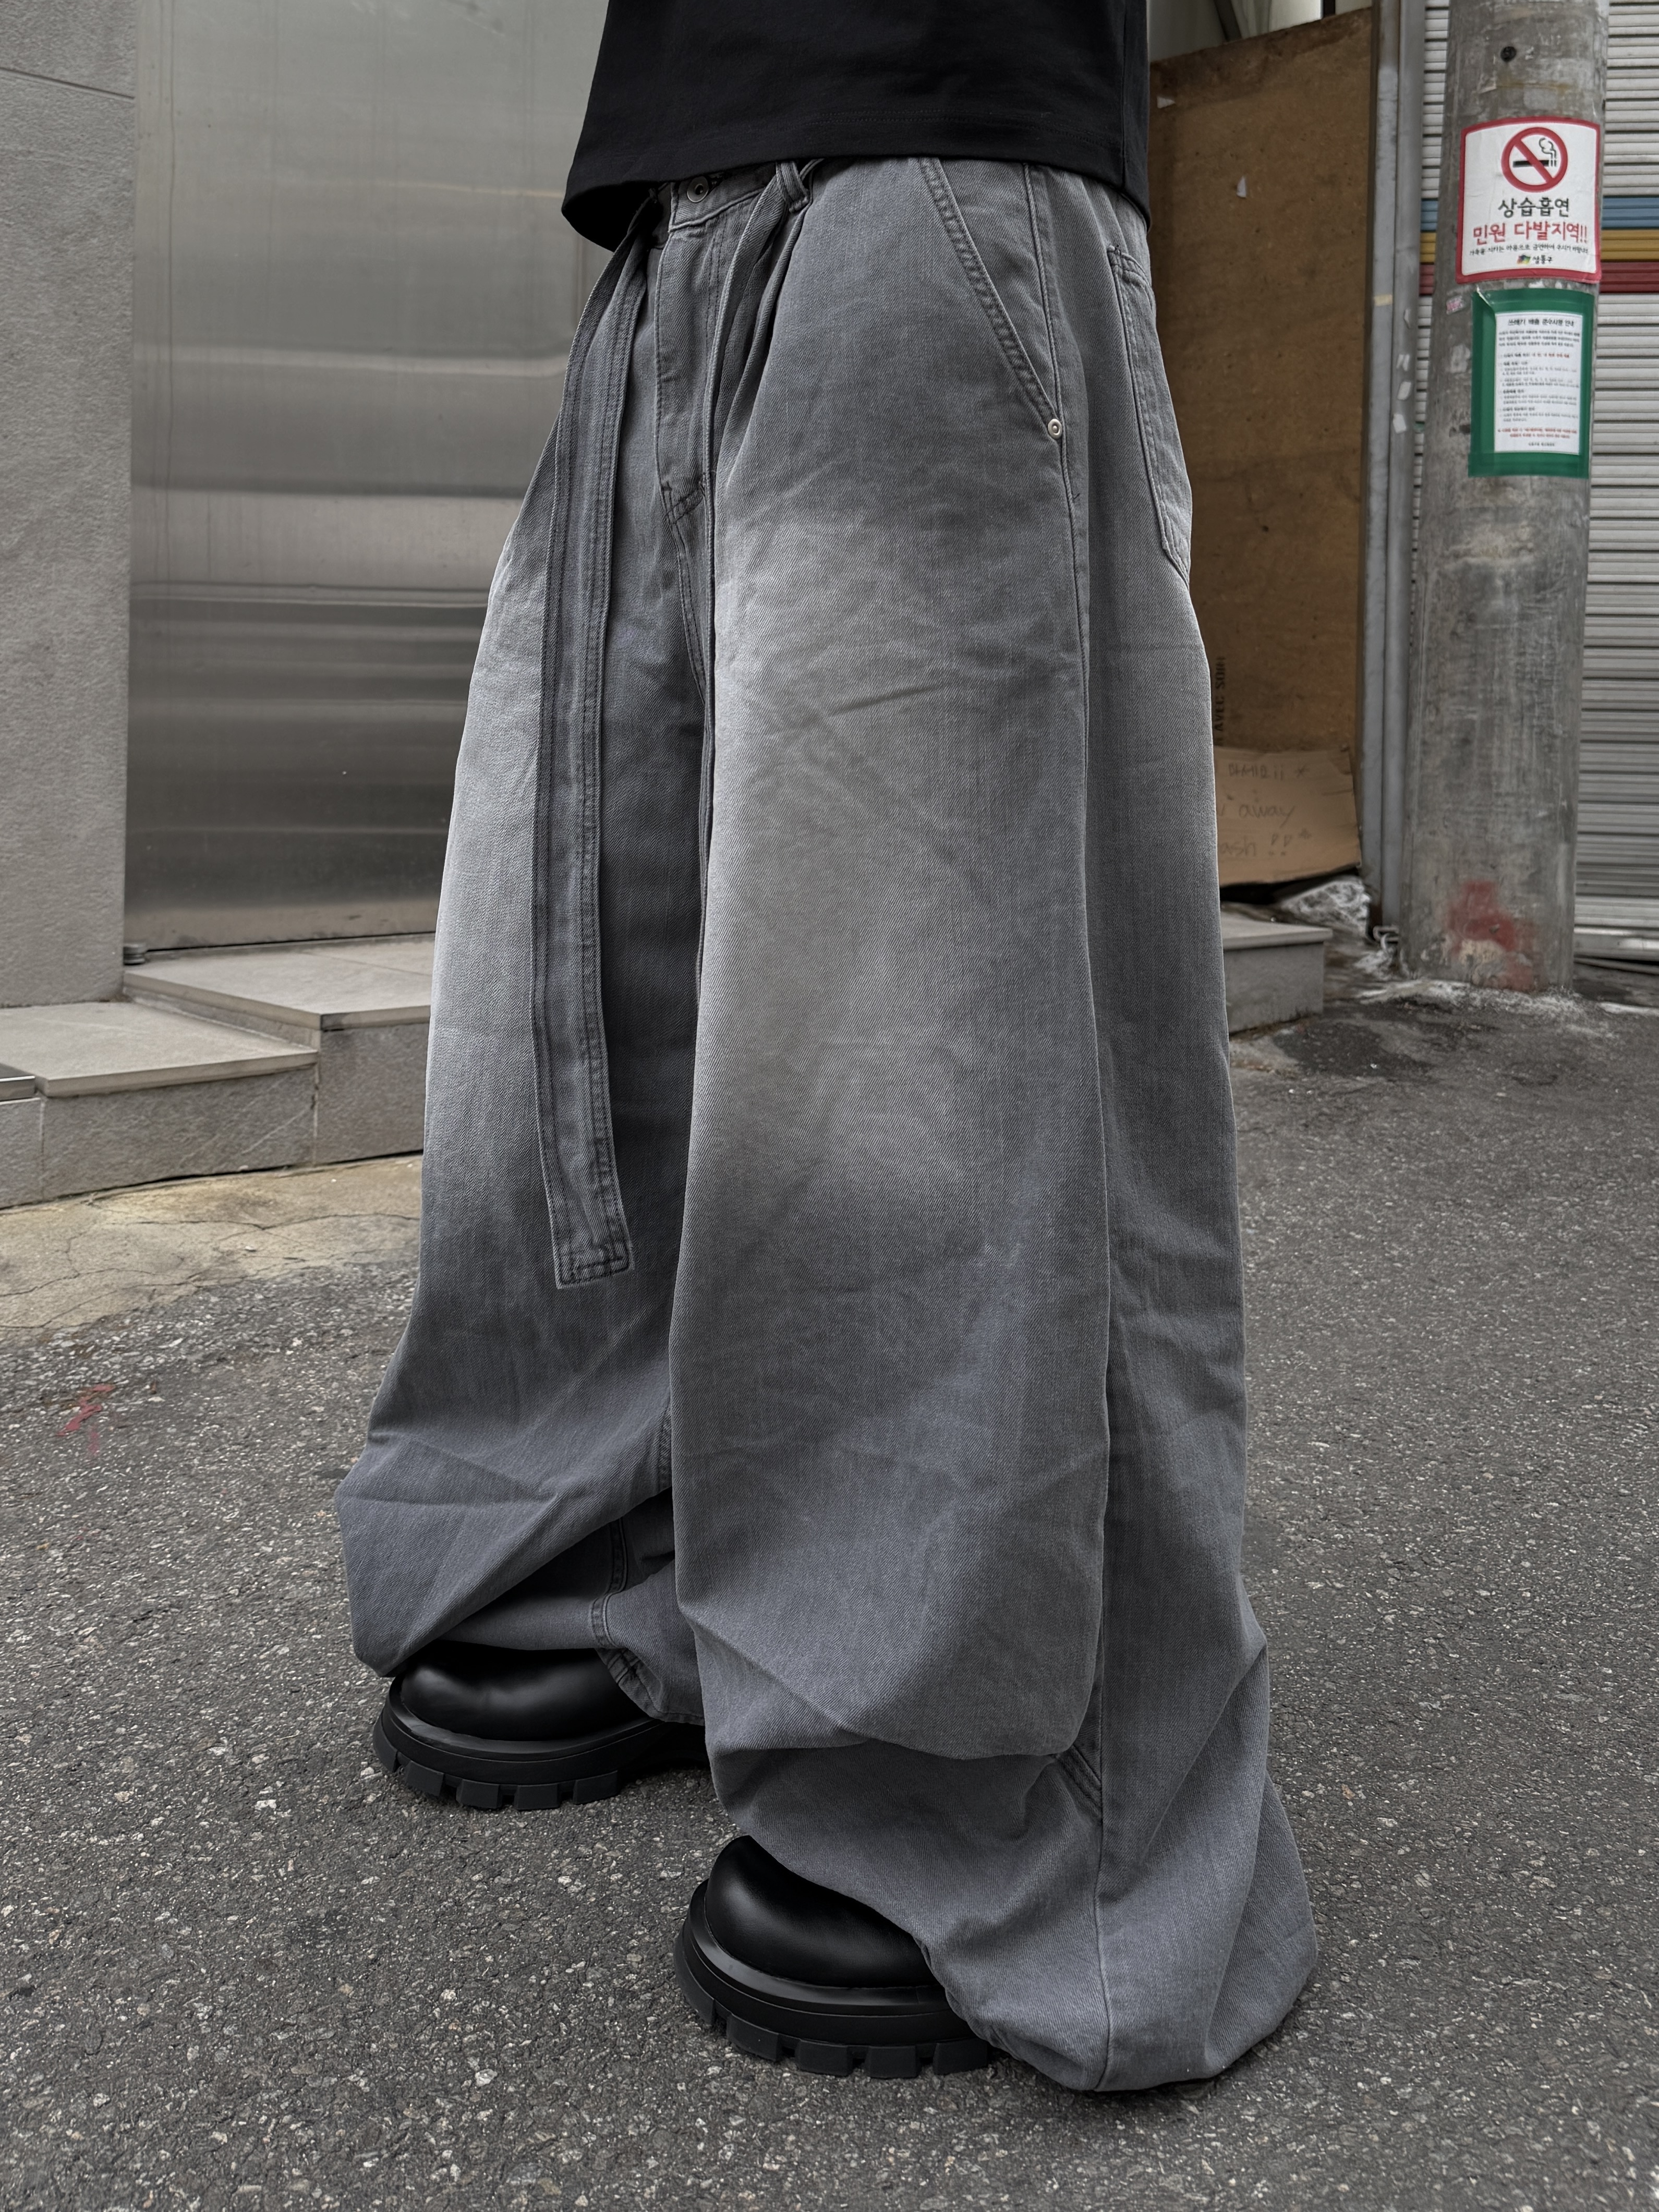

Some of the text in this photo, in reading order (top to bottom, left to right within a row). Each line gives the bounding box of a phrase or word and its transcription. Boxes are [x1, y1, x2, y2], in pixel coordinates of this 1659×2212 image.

[1498, 197, 1569, 218] 상습흡연
[1473, 221, 1588, 246] 민원 다발지역!!
[1214, 696, 1225, 731] AVEC
[1239, 804, 1295, 828] away
